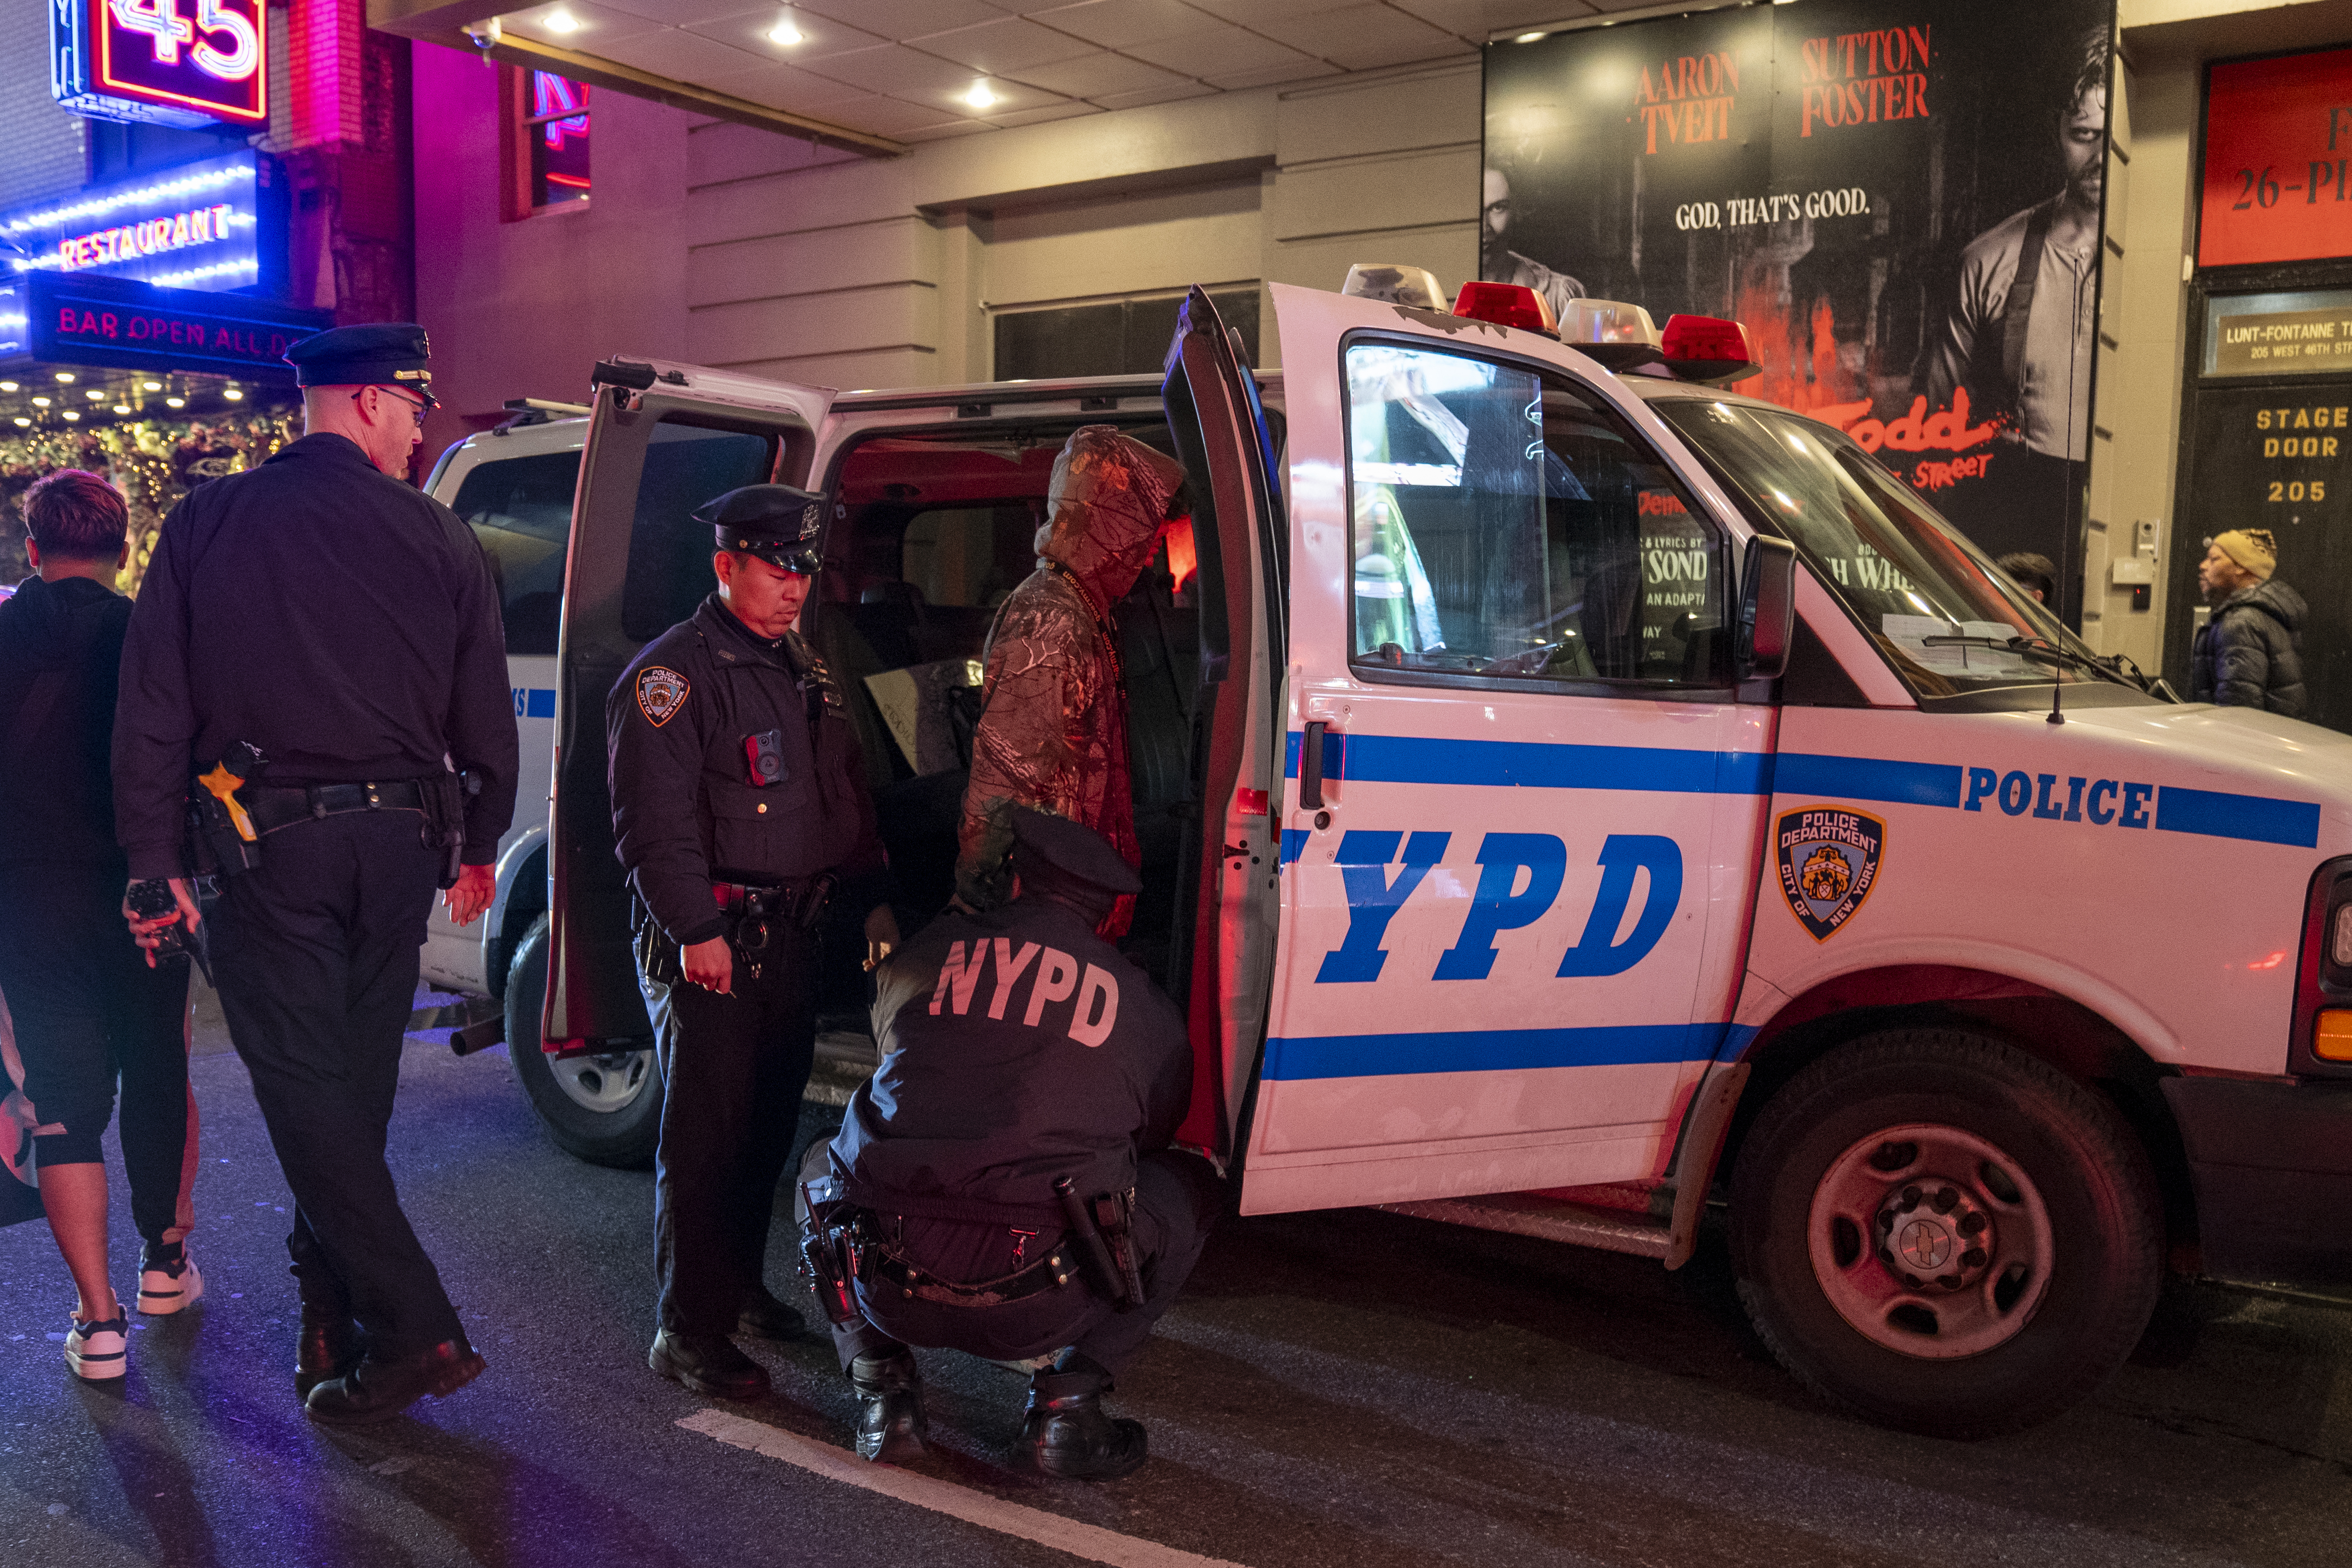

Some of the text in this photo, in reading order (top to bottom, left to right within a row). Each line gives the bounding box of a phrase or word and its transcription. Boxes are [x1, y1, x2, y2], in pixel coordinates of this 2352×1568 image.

[107, 0, 259, 81] 45
[1801, 24, 1930, 84] SUTTON
[1635, 51, 1739, 105] AARON
[1640, 96, 1734, 154] TVEIT
[1800, 73, 1929, 138] FOSTER
[2233, 159, 2352, 210] 26-PI
[1675, 187, 1871, 230] GOD, THAT'S GOOD.
[59, 203, 233, 272] RESTAURANT
[57, 308, 118, 338] BAR
[129, 316, 205, 346] OPEN
[215, 327, 261, 355] ALL
[2227, 322, 2335, 344] LUNT-FONTANNE
[2251, 346, 2268, 359] 205
[2273, 344, 2301, 358] WEST
[2256, 407, 2349, 430] STAGE
[2264, 437, 2338, 458] DOOR
[2267, 481, 2325, 502] 205
[1655, 537, 1686, 548] LYRICS
[1690, 538, 1701, 548] BY
[1062, 571, 1102, 622] goarmy.com
[1647, 593, 1662, 605] AN
[641, 676, 685, 688] DEPARTMENT
[652, 670, 678, 679] POLICE
[639, 690, 685, 719] CITY OF NEW YORK
[1963, 767, 2153, 830] POLICE
[1781, 826, 1877, 853] DEPARTMENT
[1802, 812, 1859, 832] POLICE
[1781, 861, 1876, 927] CITY OF NEW YORK
[929, 937, 1119, 1048] NYPD
